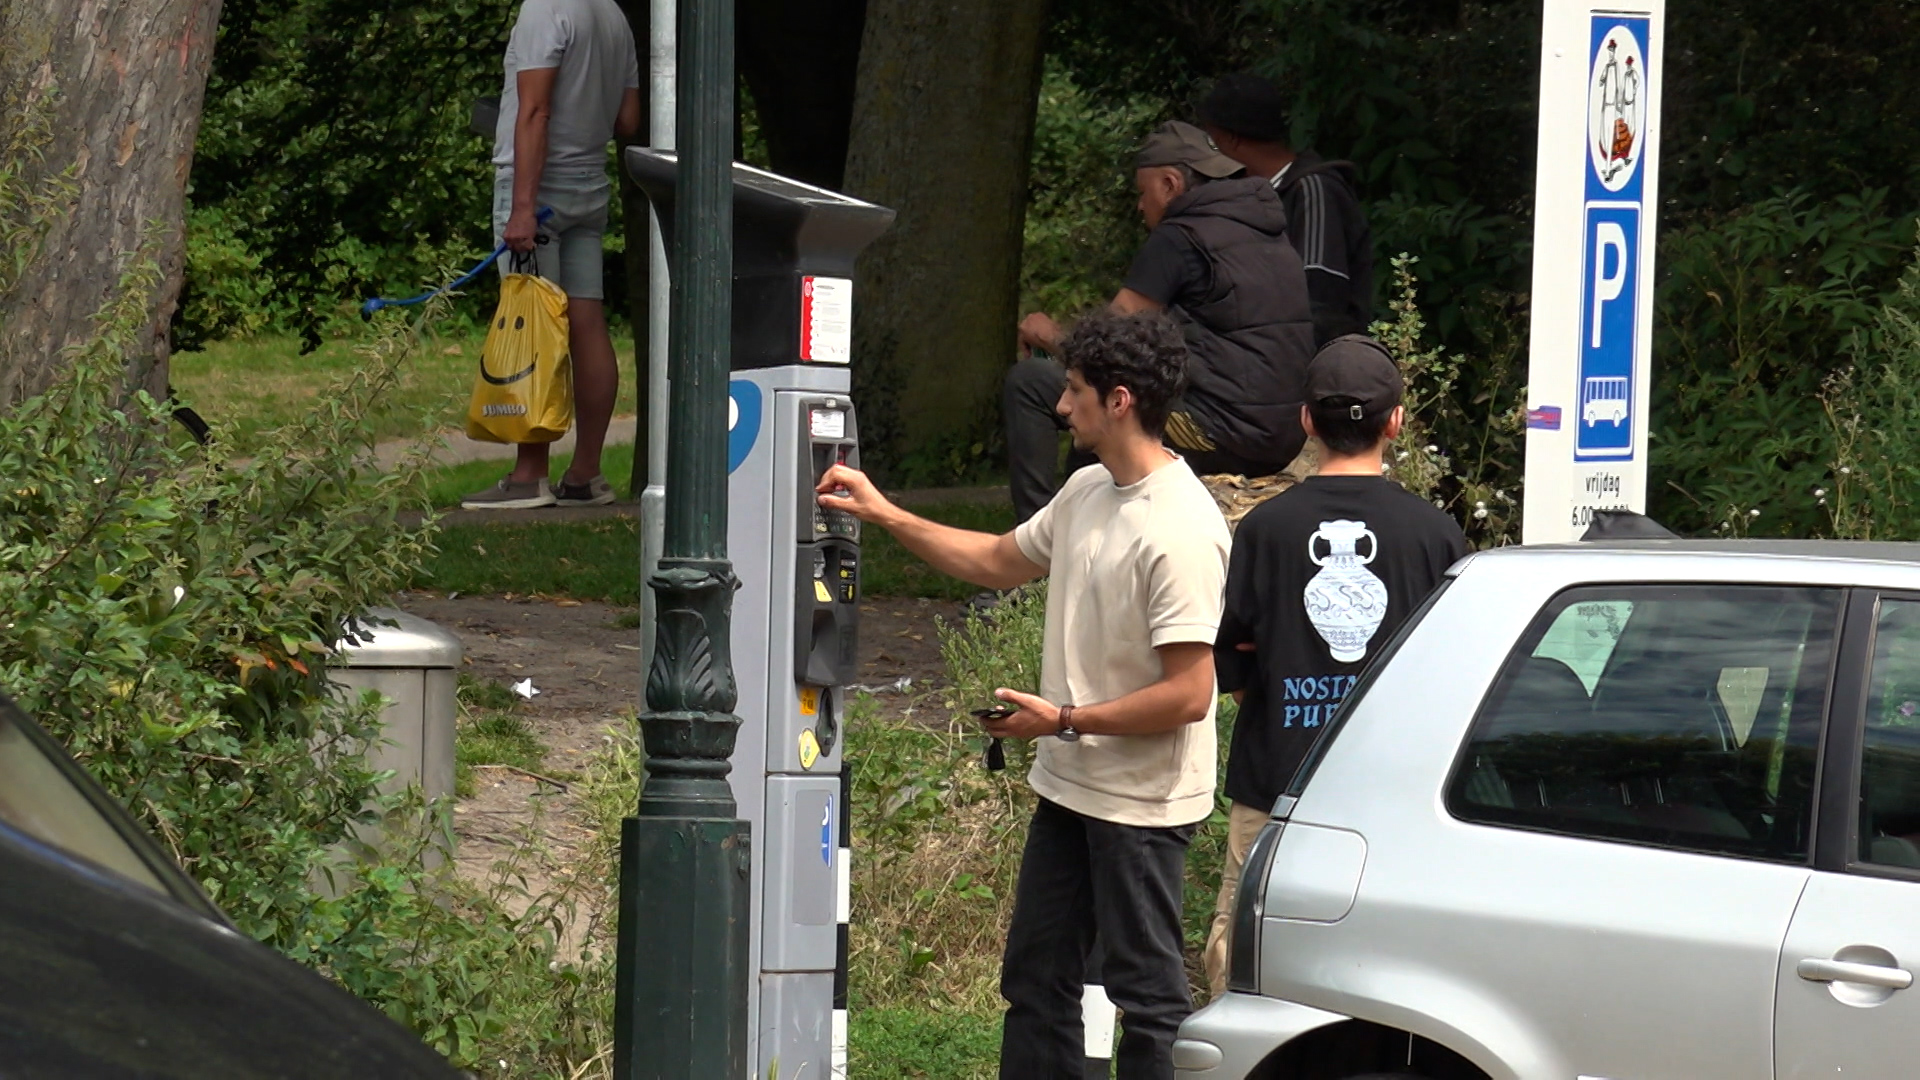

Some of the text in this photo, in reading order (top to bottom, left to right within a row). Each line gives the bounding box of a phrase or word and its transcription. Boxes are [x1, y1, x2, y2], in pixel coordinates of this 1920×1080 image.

[1591, 221, 1628, 349] P
[482, 403, 527, 417] JUMBO
[1585, 471, 1621, 499] vrijdag
